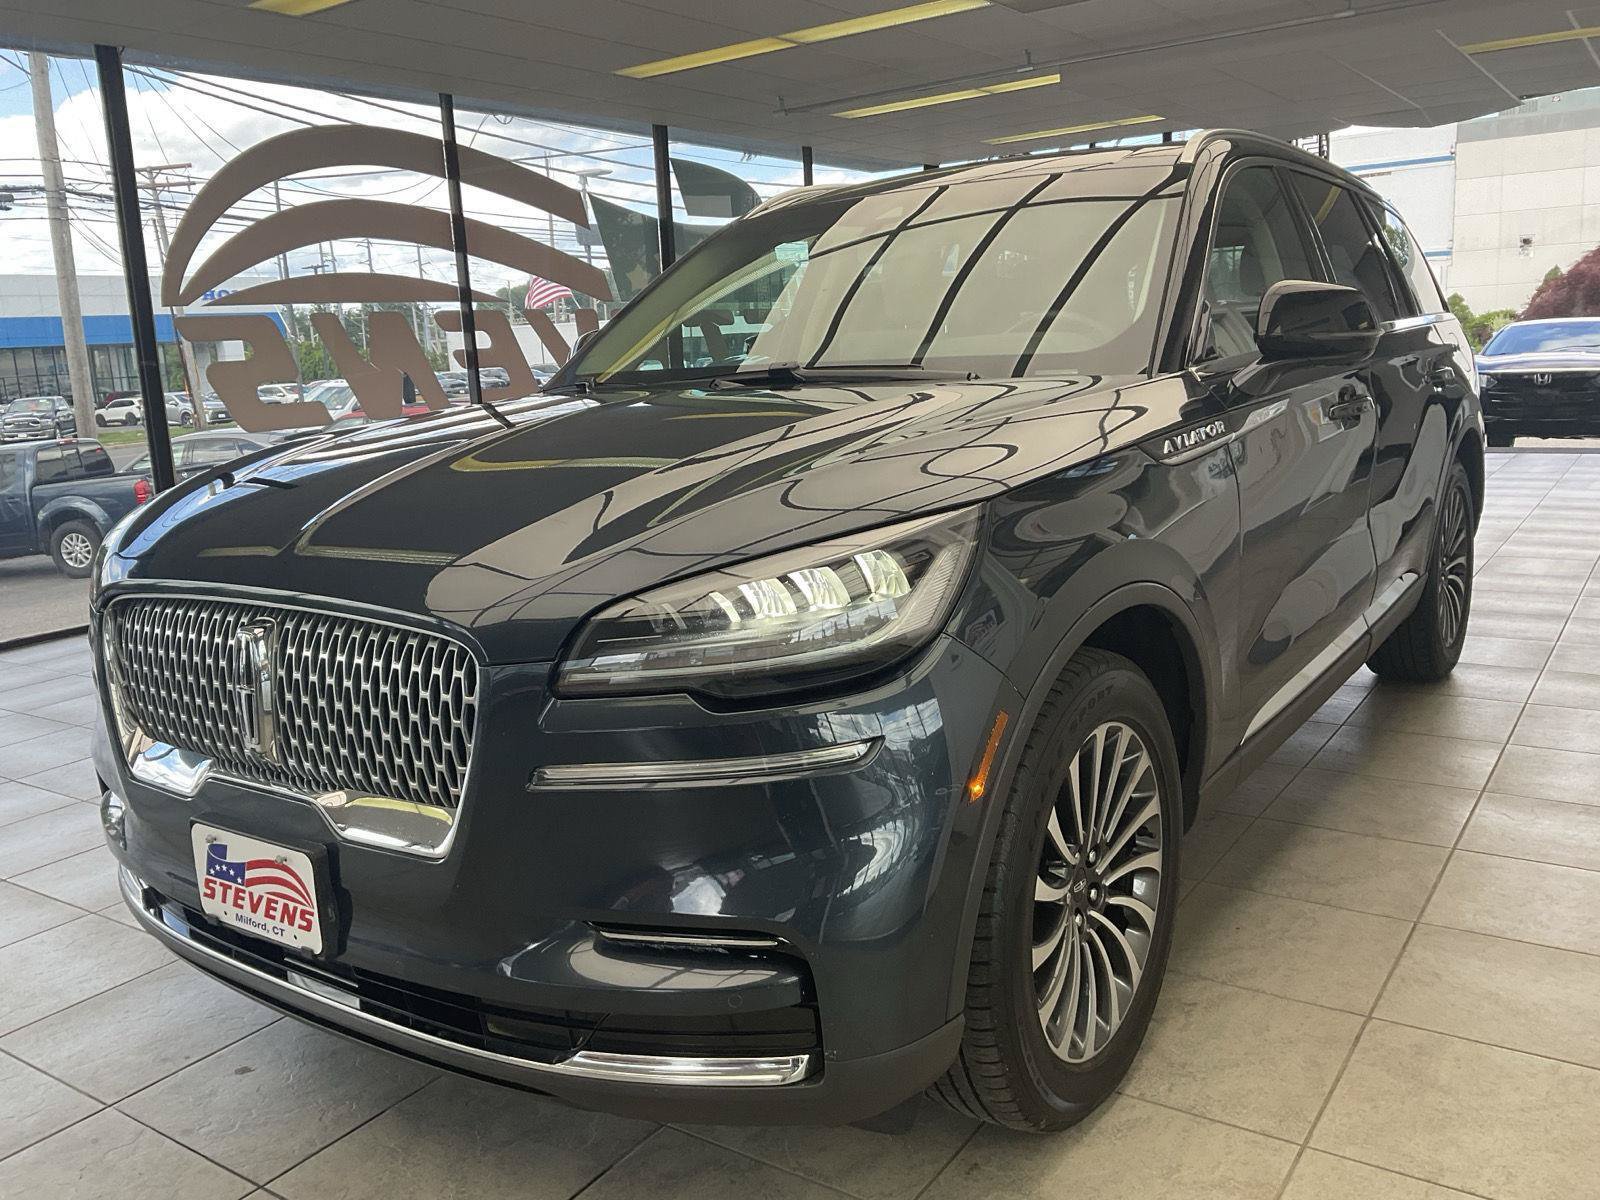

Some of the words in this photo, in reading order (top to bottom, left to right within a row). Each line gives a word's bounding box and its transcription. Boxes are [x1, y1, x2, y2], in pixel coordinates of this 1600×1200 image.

[1163, 420, 1226, 454] AVIATOR
[202, 877, 315, 933] STEVENS
[235, 912, 270, 934] Milford,
[272, 925, 286, 937] CT
